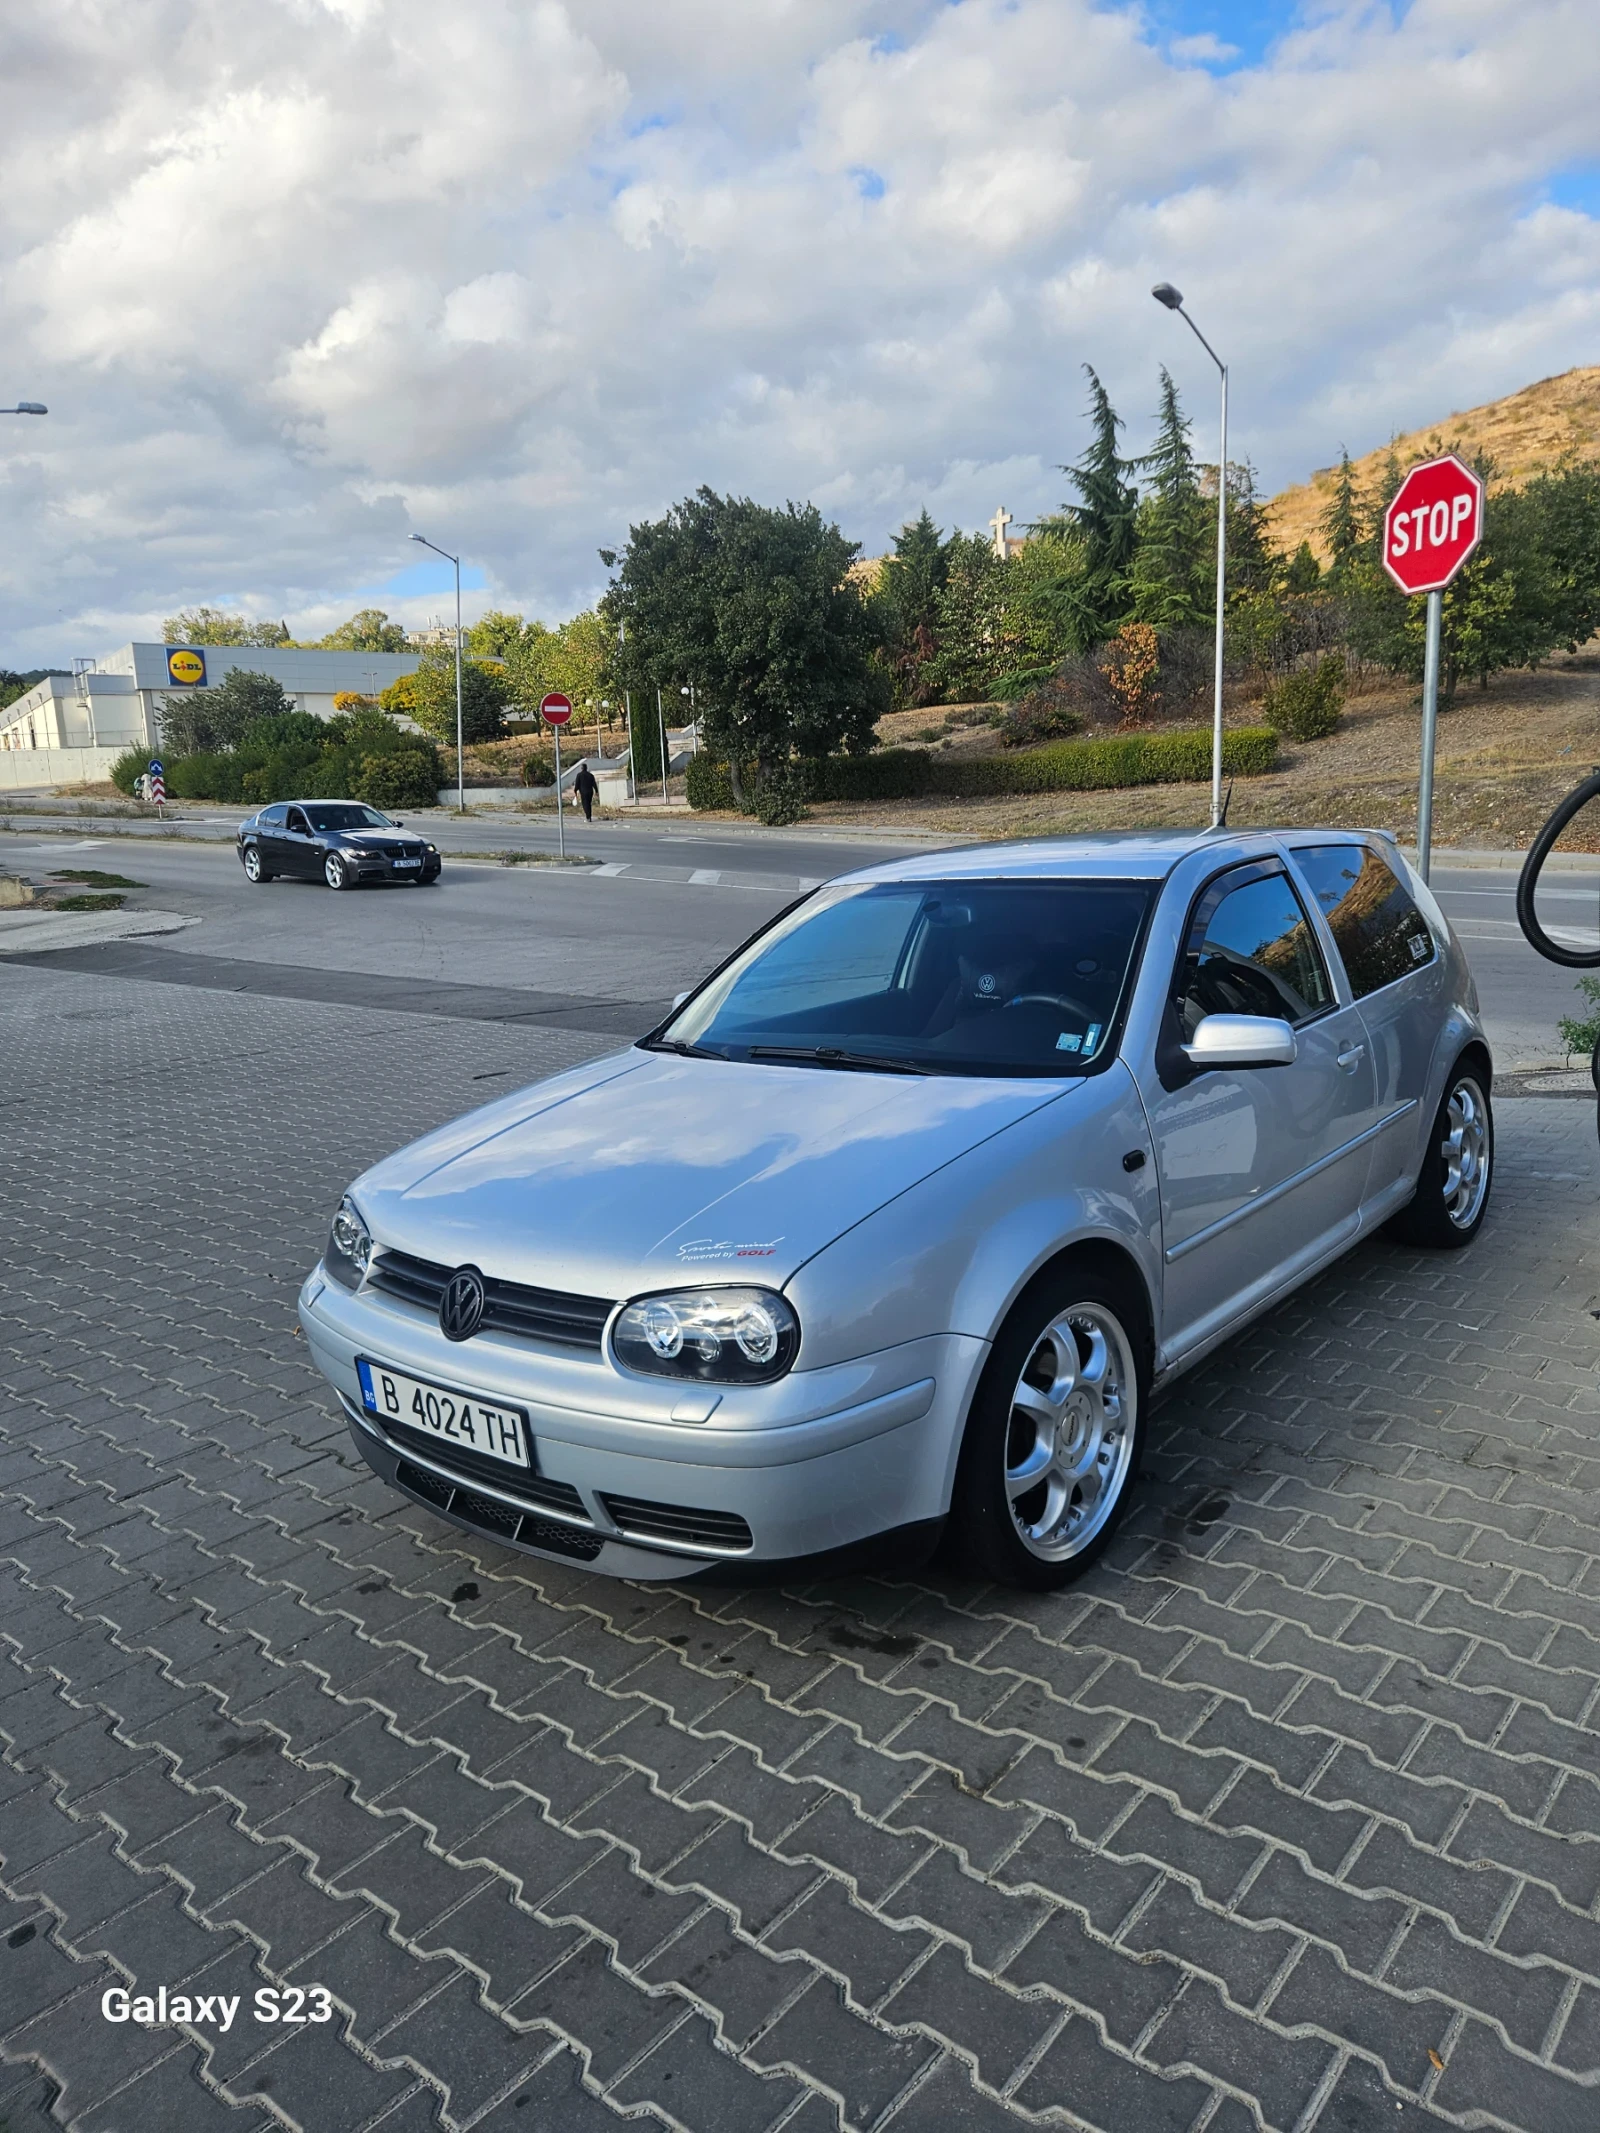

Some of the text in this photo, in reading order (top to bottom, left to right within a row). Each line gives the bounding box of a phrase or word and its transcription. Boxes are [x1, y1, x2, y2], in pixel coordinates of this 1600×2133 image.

[1391, 494, 1472, 557] STOP
[681, 1252, 721, 1262] Powered
[737, 1249, 777, 1257] GOLF
[365, 1390, 375, 1403] BG
[381, 1374, 400, 1414] B
